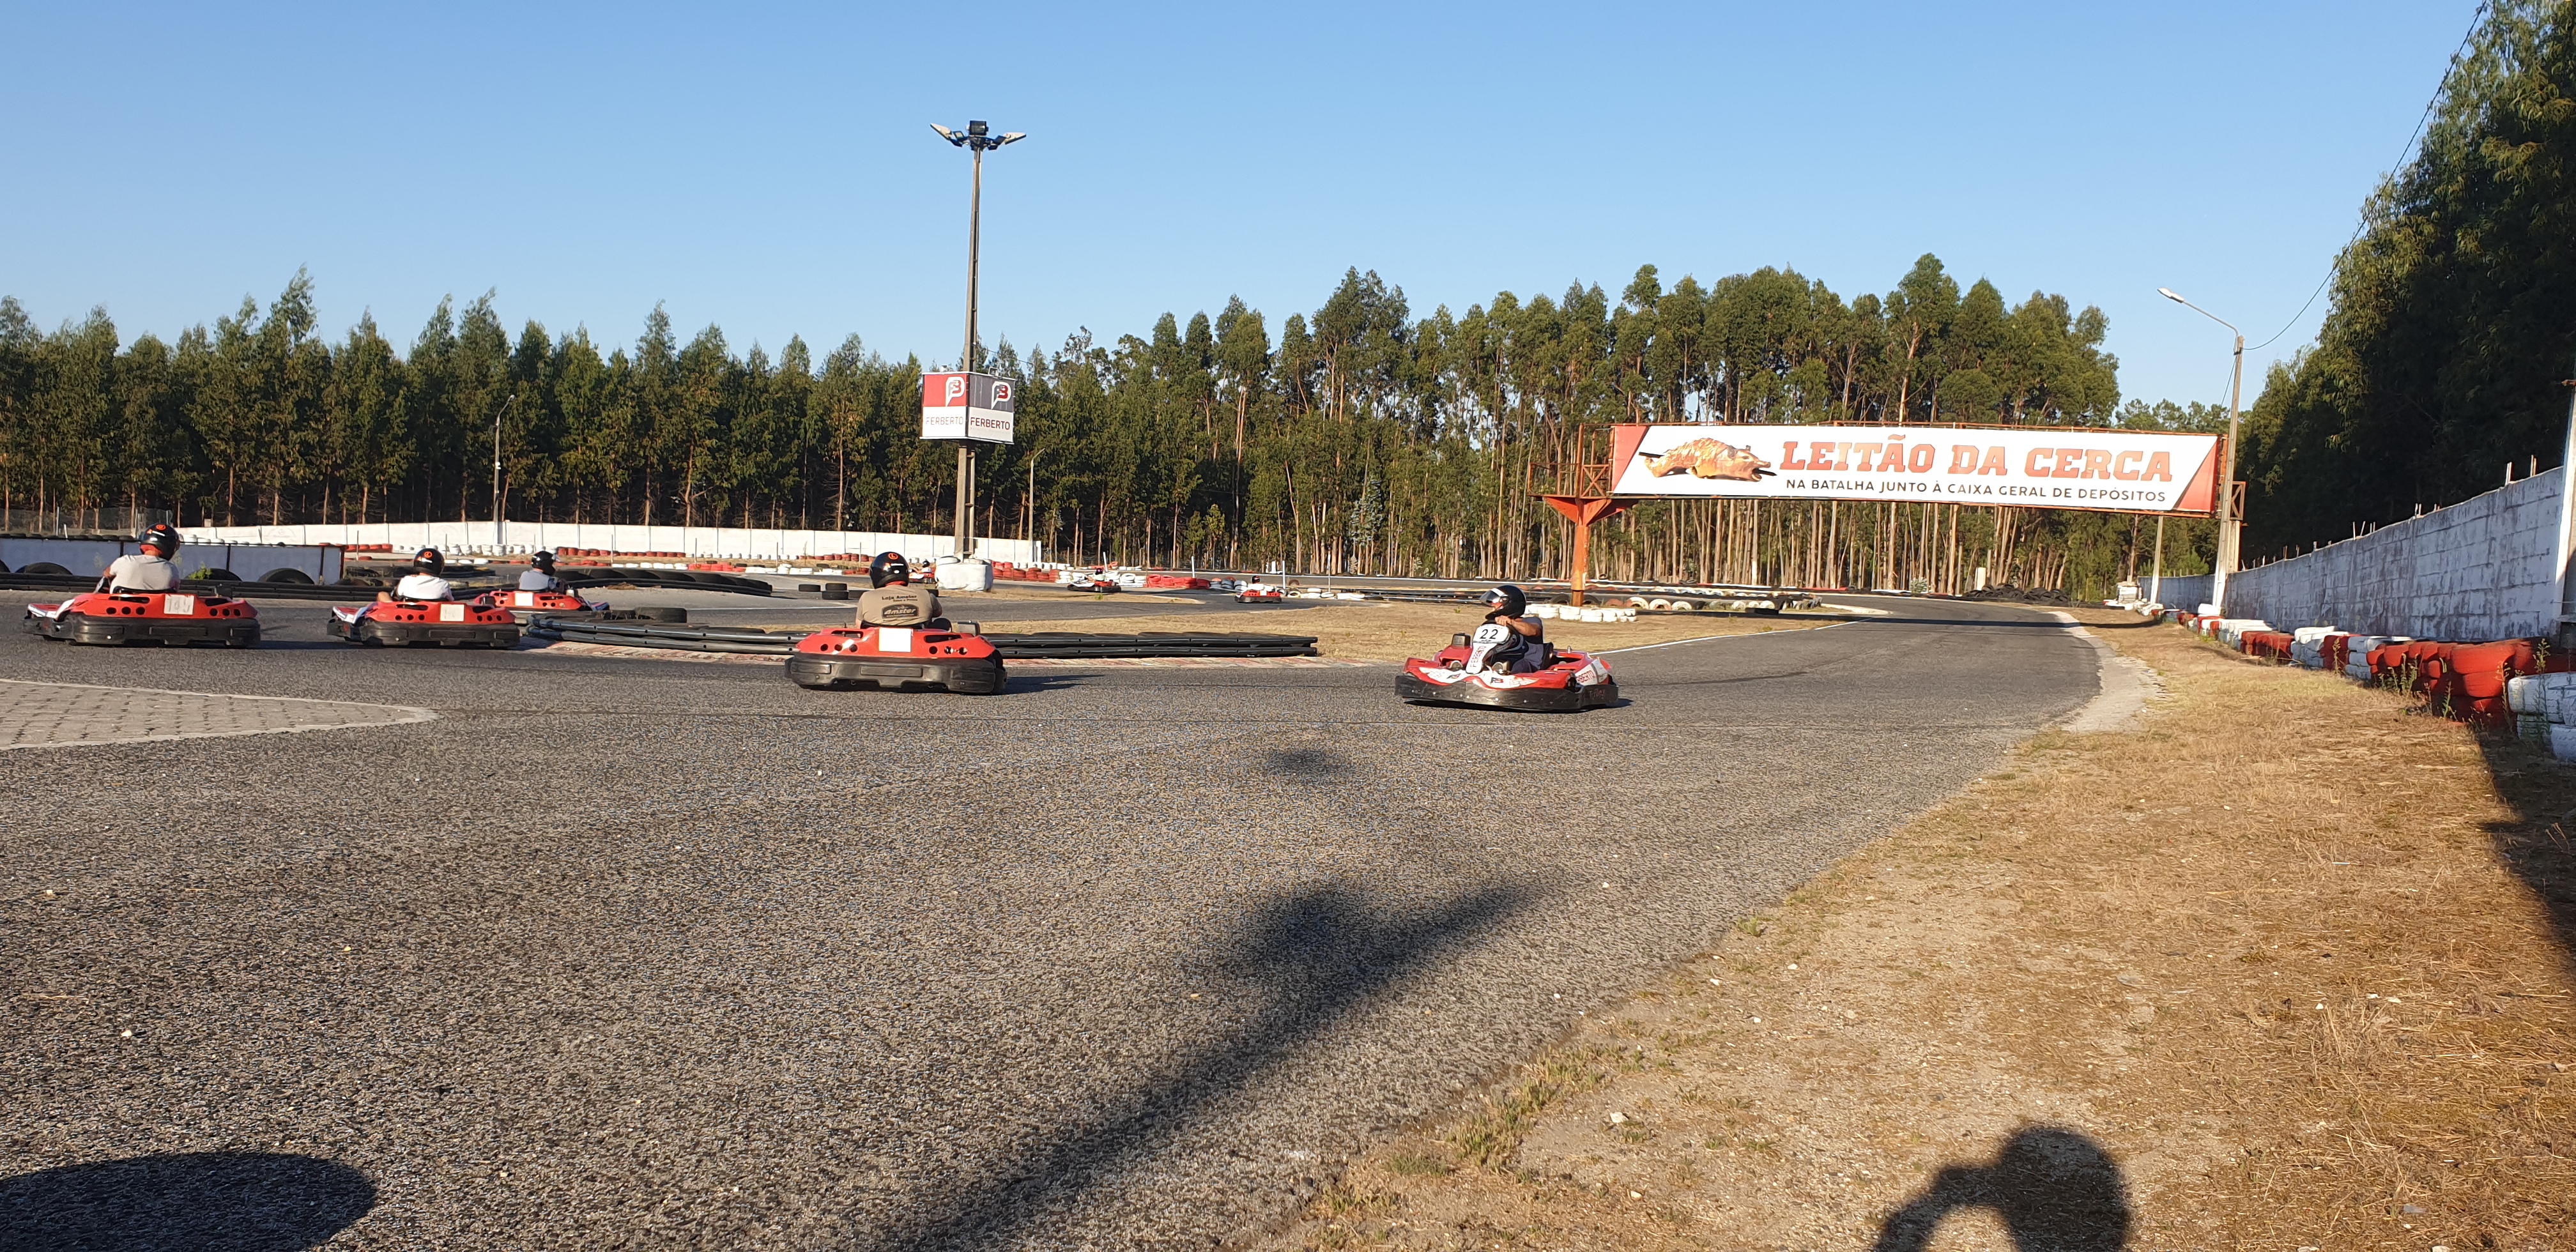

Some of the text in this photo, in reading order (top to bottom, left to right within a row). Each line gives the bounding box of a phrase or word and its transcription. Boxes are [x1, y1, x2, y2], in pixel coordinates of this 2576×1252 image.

[926, 416, 964, 425] FERBERTO
[970, 416, 1010, 431] FERBERTO
[1779, 434, 2173, 482] LEITÃO DA CERCA
[1786, 479, 1806, 489] NA
[1811, 480, 1874, 491] BATALHA
[1879, 481, 1927, 493] JUNTO
[1947, 484, 1993, 495] CAIXA
[1998, 485, 2047, 498] GERAL
[2053, 487, 2073, 498] DE
[2078, 487, 2166, 502] DEPÓSITOS
[1479, 629, 1498, 639] 22
